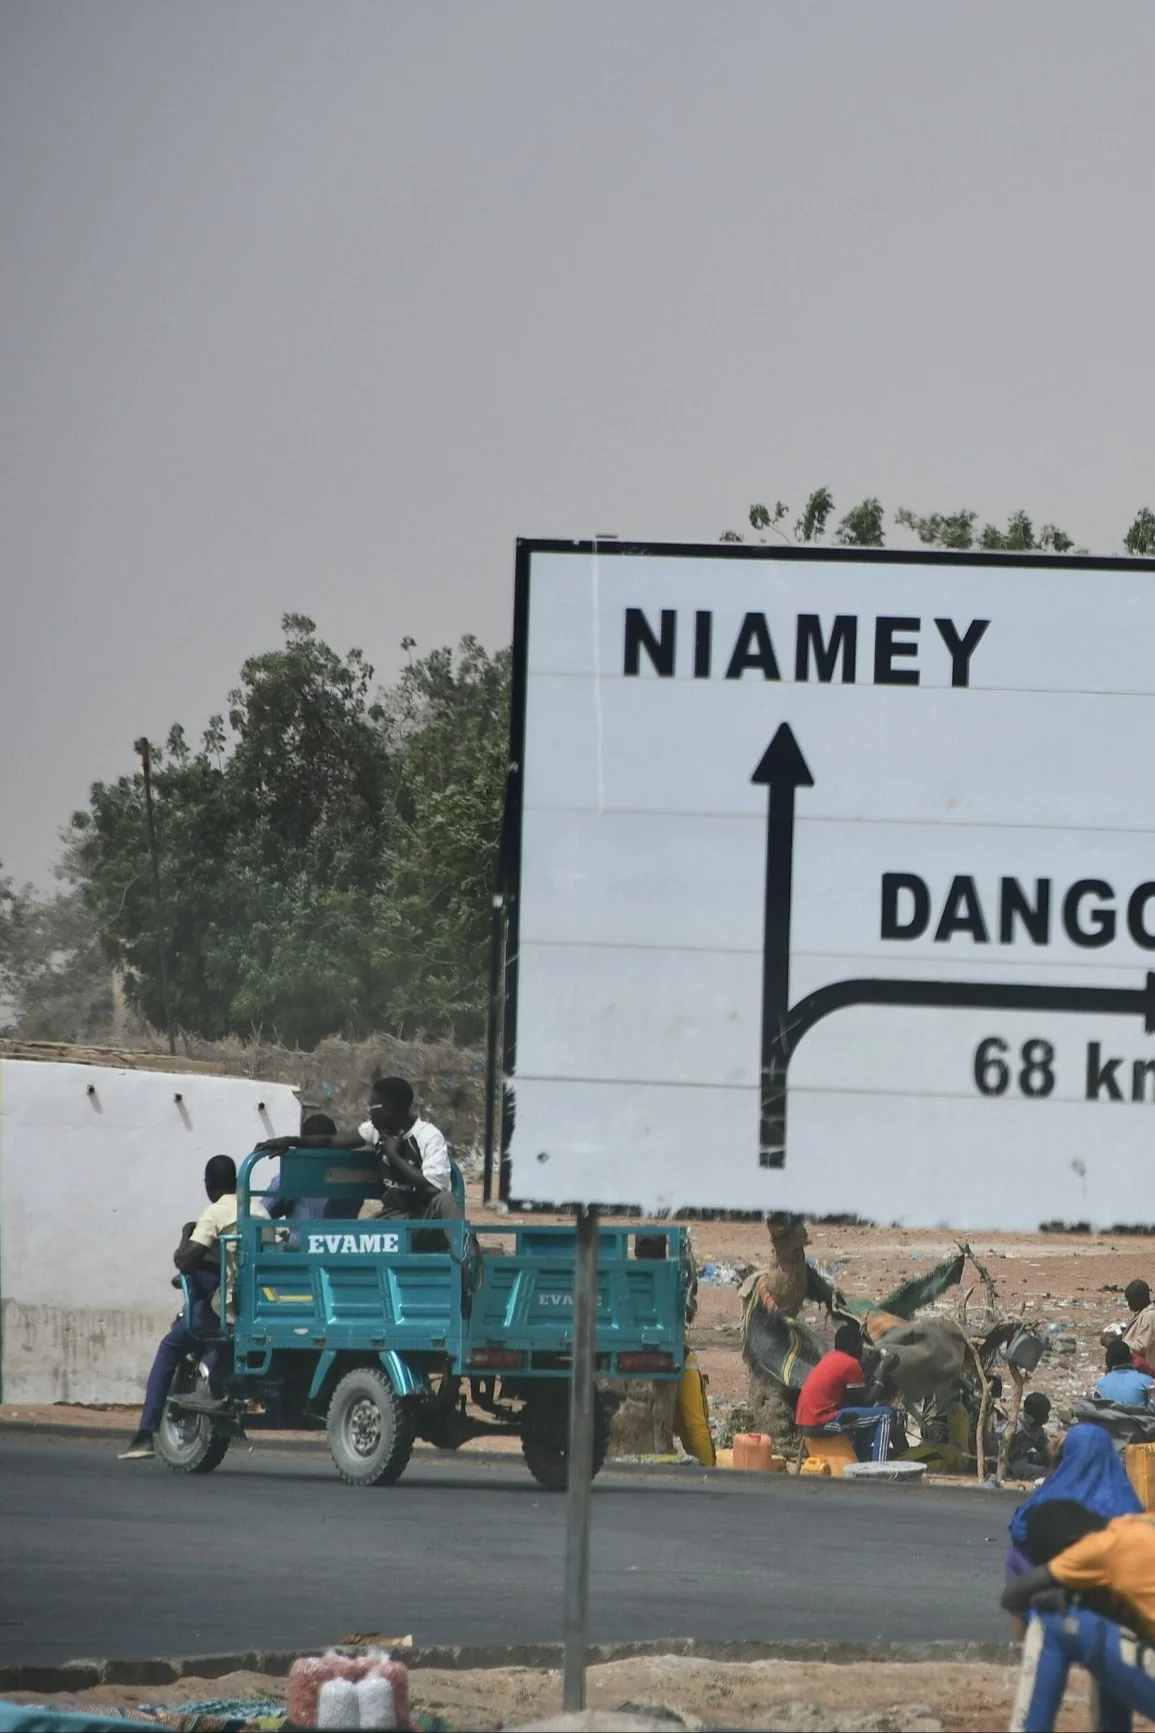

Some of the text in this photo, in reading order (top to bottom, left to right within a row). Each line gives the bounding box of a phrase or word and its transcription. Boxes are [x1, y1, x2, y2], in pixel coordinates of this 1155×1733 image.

[623, 607, 992, 689] NIAMEY
[973, 1036, 1056, 1099] 68
[308, 1233, 399, 1254] EVAME
[539, 1294, 603, 1307] EVA
